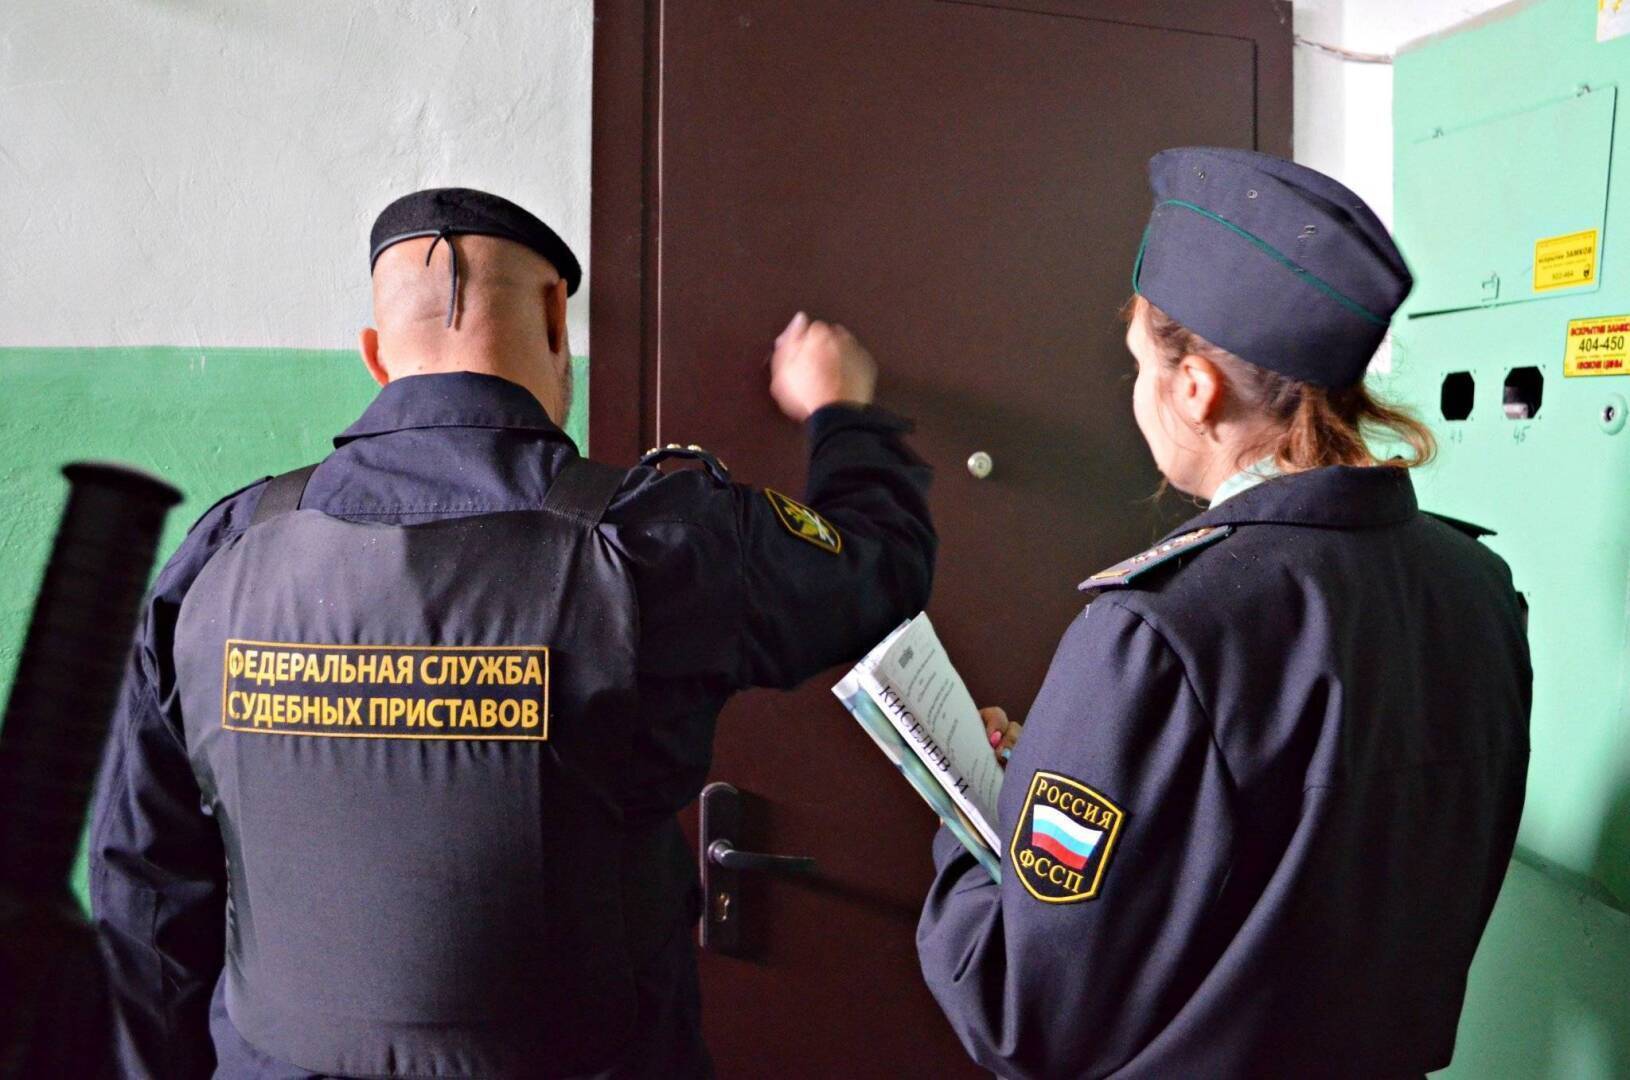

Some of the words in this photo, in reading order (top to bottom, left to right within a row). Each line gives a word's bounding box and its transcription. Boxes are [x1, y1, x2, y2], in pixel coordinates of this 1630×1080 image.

[1579, 336, 1624, 352] 404-450
[228, 647, 413, 686] ФЕДЕРАЛЬНАЯ
[420, 655, 543, 686] СЛУЖБА
[228, 691, 363, 728] СУДЕБНЫХ
[369, 698, 539, 728] ПРИСТАВОВ
[879, 686, 951, 773] КИСЕЛЕВ
[954, 777, 969, 800] И.
[1036, 779, 1114, 829] РОССИЯ
[1019, 849, 1084, 893] ФССП
